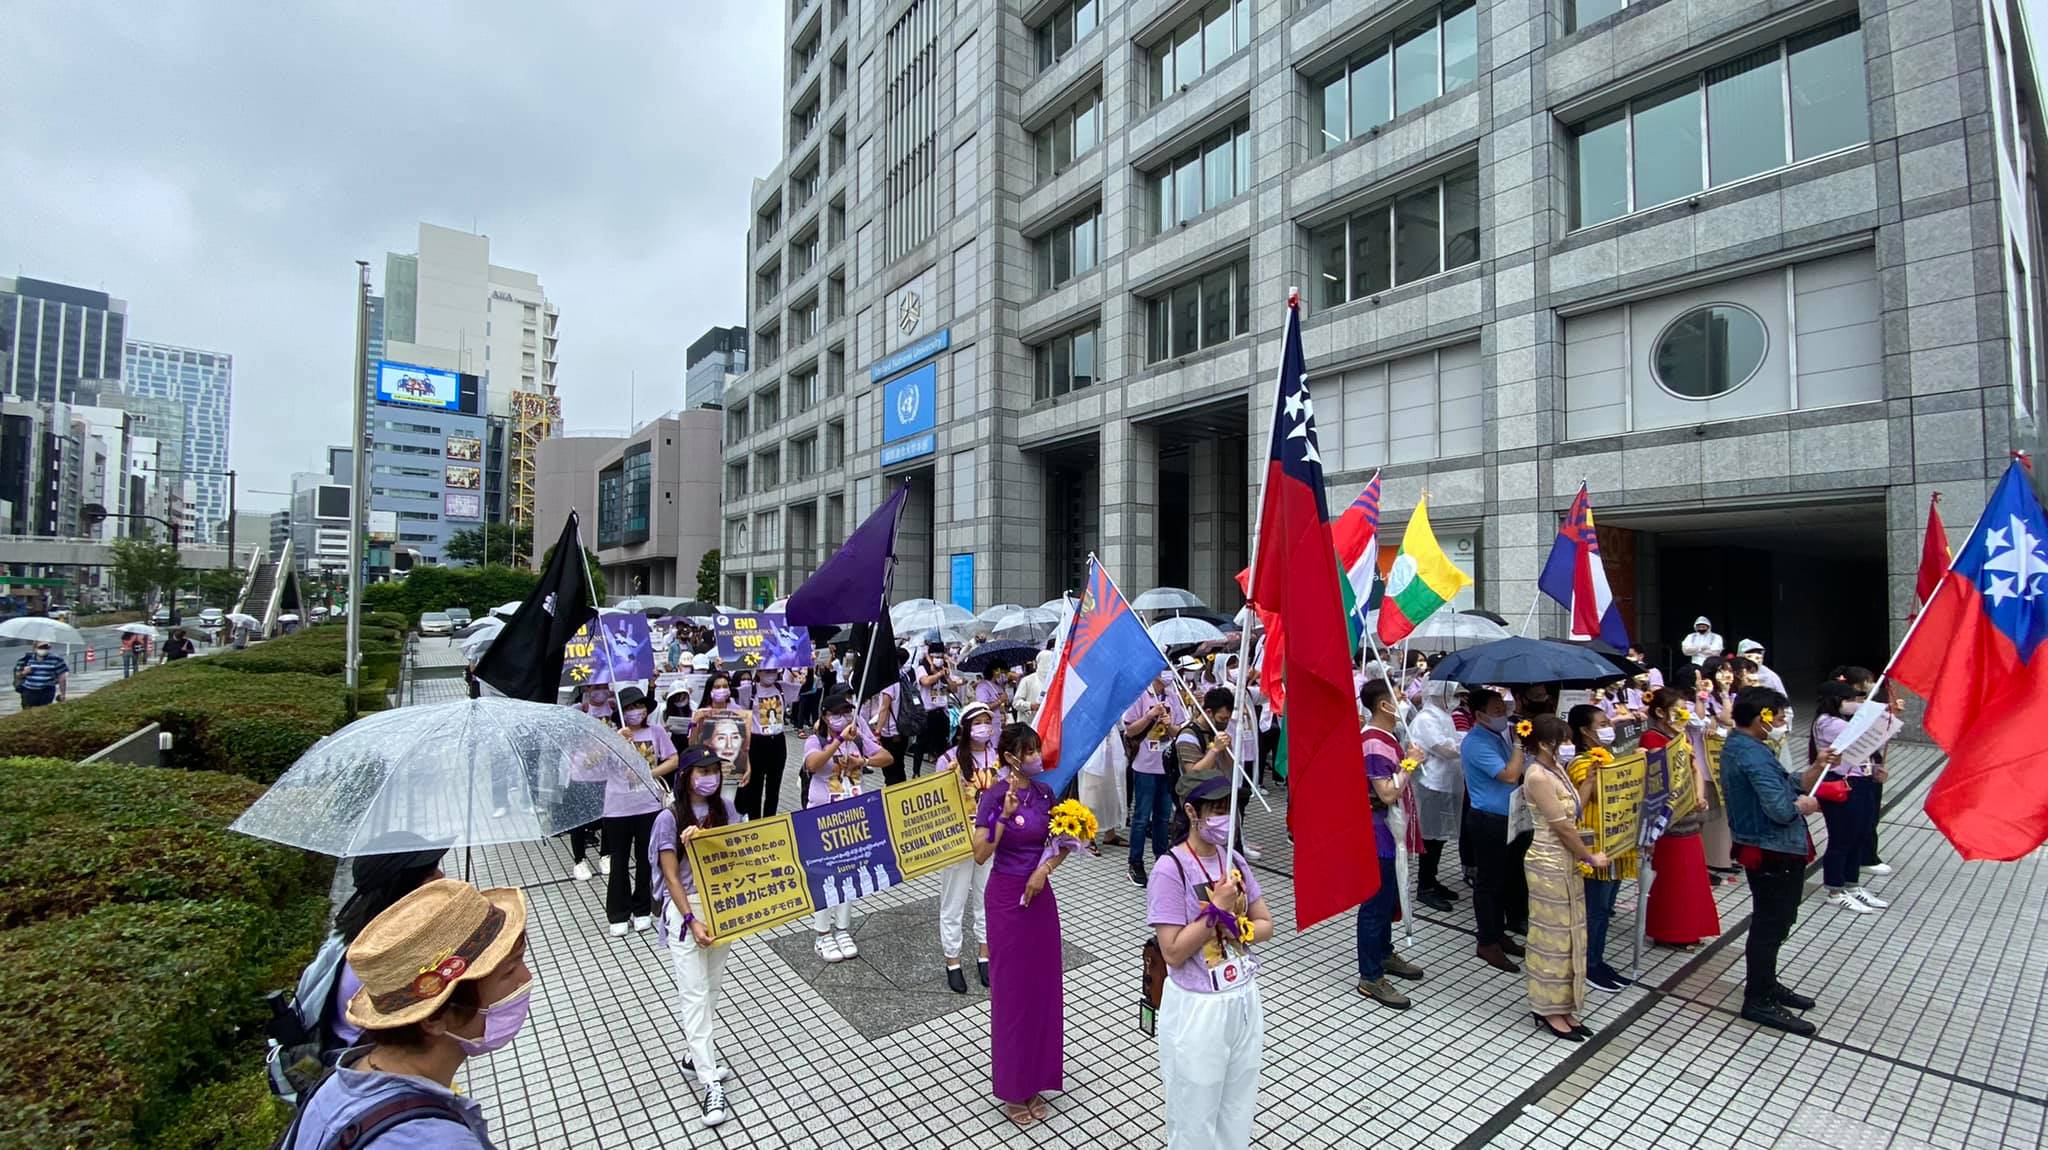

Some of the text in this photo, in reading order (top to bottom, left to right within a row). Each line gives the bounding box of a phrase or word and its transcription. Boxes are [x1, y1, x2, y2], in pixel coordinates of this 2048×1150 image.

[734, 617, 757, 630] END
[733, 634, 764, 648] STOP
[901, 787, 949, 816] GLOBAL
[817, 806, 866, 831] MARCHING
[901, 812, 957, 839] PROTESTING AGAINST
[903, 804, 951, 828] DEMONSTRATION
[820, 820, 872, 852] STRIKE
[899, 835, 930, 855] SEXUAL
[928, 821, 966, 844] VIOLENCE
[710, 865, 796, 896] ミャンマー軍の
[713, 878, 797, 914] 性的暴力に対する
